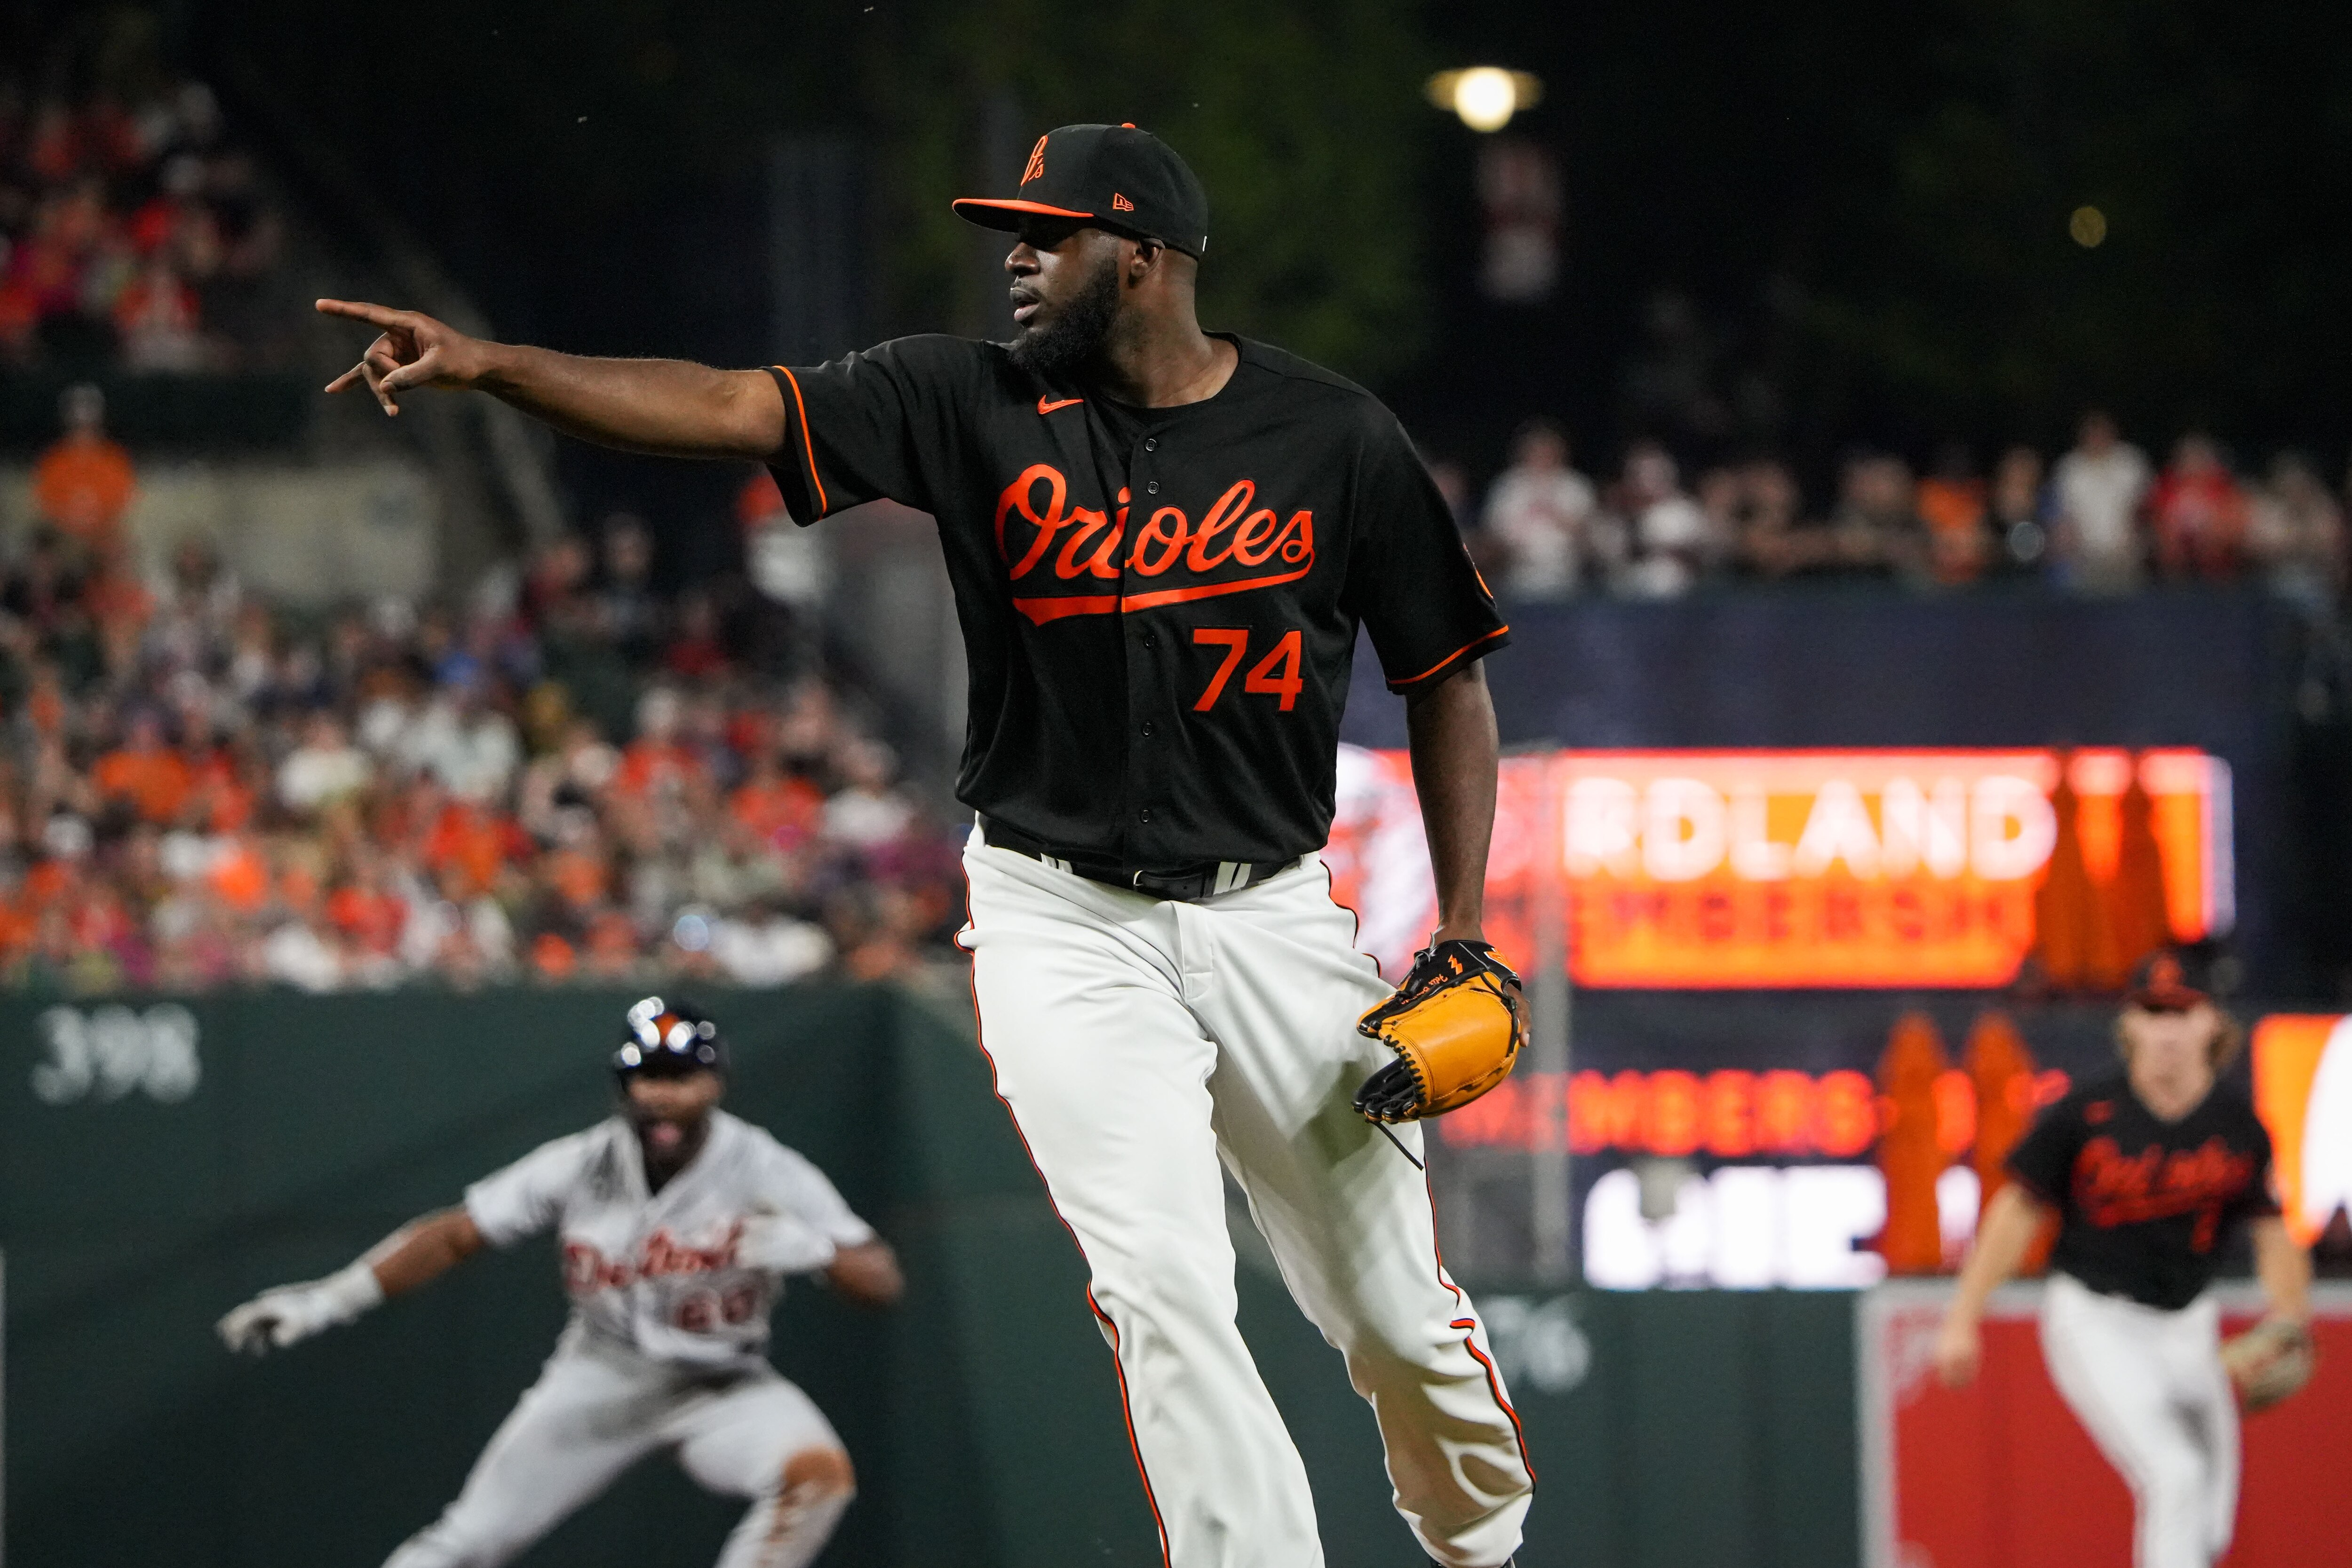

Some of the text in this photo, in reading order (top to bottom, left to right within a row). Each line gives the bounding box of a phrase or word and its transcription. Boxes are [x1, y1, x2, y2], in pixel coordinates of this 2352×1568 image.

[995, 464, 1315, 626] Orioles
[1193, 629, 1303, 711] 74
[1489, 777, 2057, 882] RDLAND
